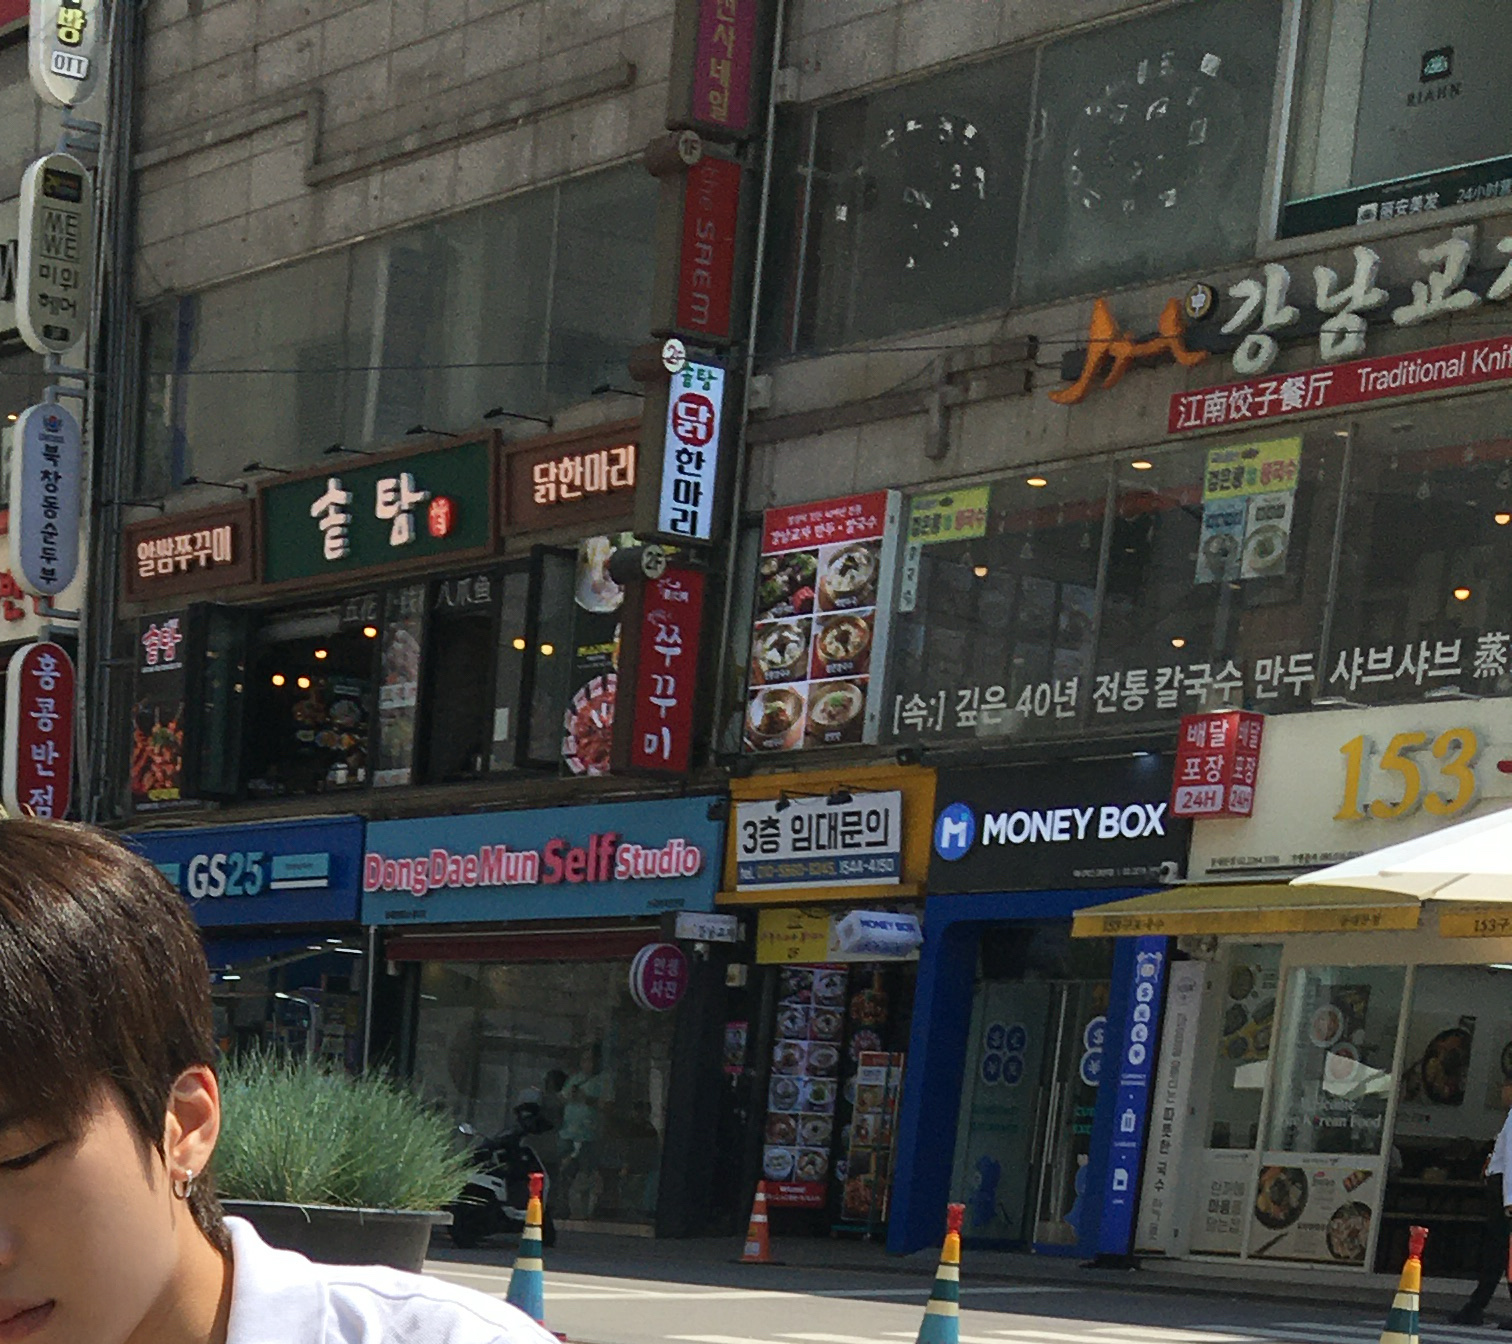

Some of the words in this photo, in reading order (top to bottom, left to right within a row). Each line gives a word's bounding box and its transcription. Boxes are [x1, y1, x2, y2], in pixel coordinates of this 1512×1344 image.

[54, 54, 85, 74] OTT
[1358, 355, 1466, 394] Traditional
[1176, 371, 1334, 429] 江南饺子餐厅
[533, 446, 637, 504] 닭한마리
[670, 401, 714, 536] 닭한마리
[644, 623, 683, 761] 쭈꾸미
[955, 686, 1007, 728] 깊은
[1015, 676, 1077, 718] 40년
[1255, 653, 1315, 699] 만두
[1329, 639, 1462, 691] 샤브샤브
[1473, 631, 1512, 679] 蒸
[29, 653, 62, 819] 홍콩반점
[1187, 718, 1229, 748] 배달
[1181, 754, 1225, 782] 포장
[1333, 727, 1479, 821] 153
[982, 806, 1095, 846] MONEY
[1098, 802, 1168, 839] BOX
[1182, 788, 1218, 810] 24H
[742, 815, 781, 854] 3층
[791, 808, 889, 852] 임대문의
[187, 851, 264, 898] GS25
[541, 831, 617, 885] Self
[614, 838, 702, 880] Studio
